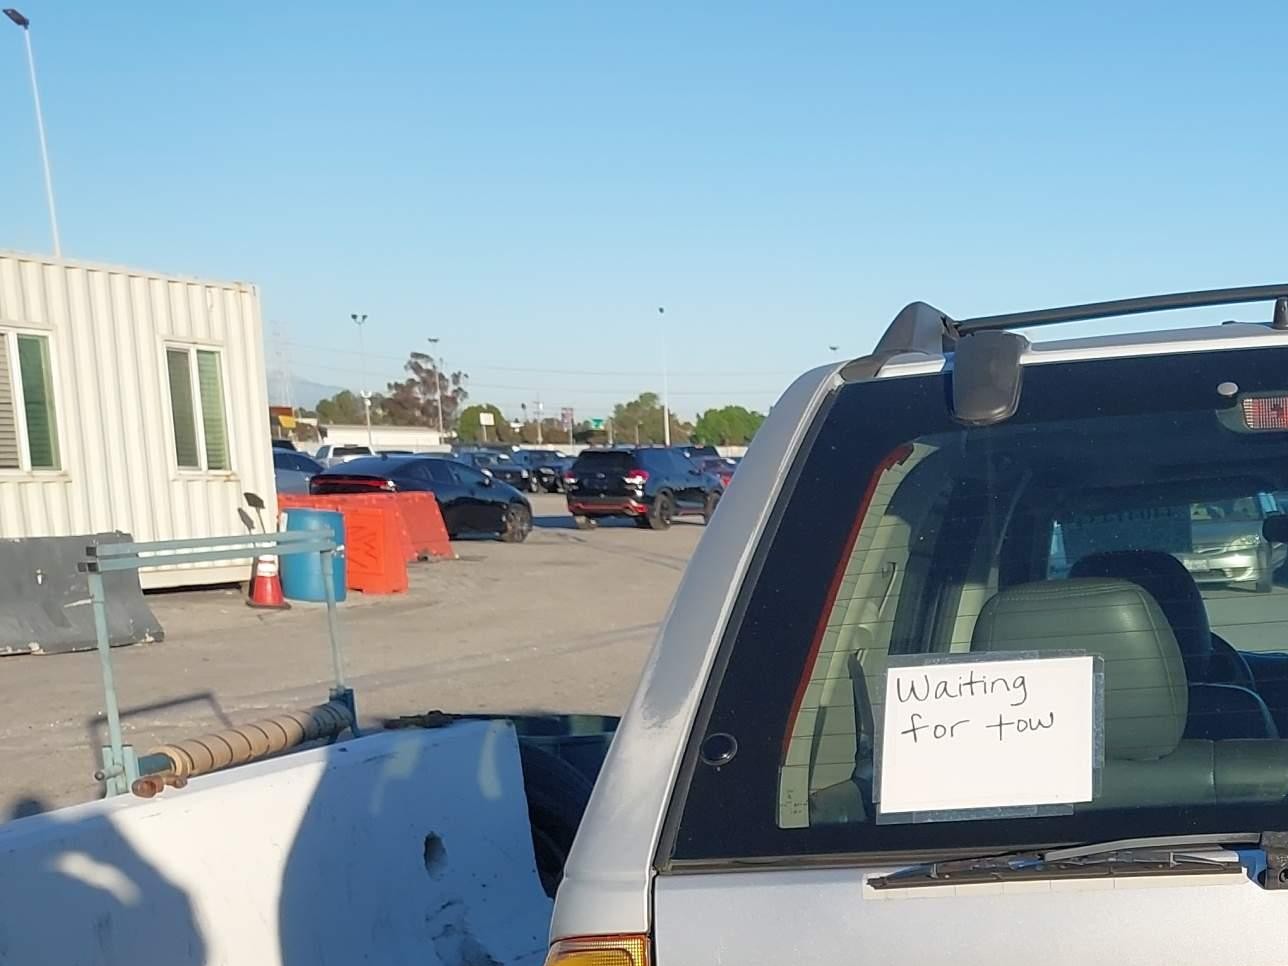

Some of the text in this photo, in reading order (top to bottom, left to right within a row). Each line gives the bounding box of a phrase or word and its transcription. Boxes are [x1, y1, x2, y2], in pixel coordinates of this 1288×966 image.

[896, 670, 1028, 707] Waiting
[900, 711, 1055, 743] for tow
